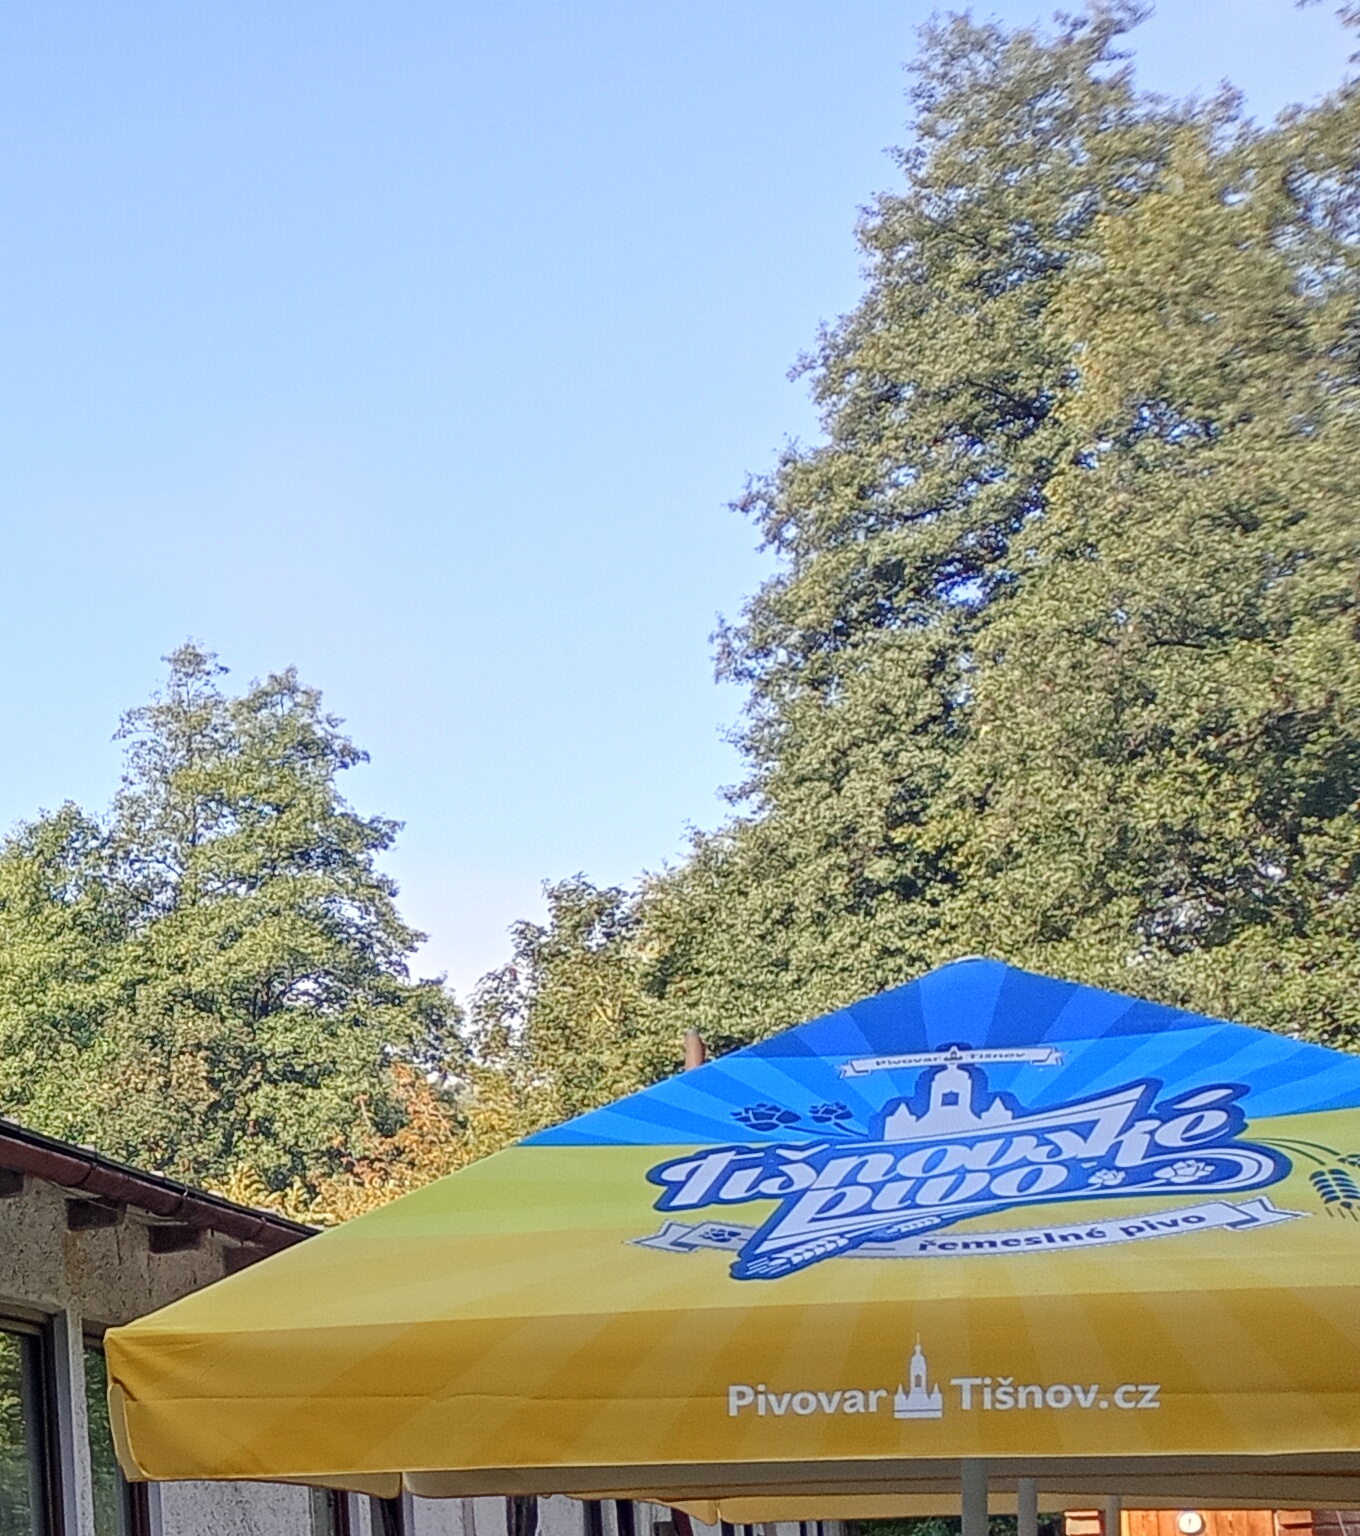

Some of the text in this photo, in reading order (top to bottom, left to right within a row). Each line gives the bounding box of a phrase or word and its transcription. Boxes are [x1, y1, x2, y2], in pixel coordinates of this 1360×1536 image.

[875, 1056, 938, 1067] Pivovar
[660, 1084, 1236, 1208] Tišnovské
[754, 1163, 1076, 1254] pivo
[918, 1214, 1207, 1251] řemeslné pivo
[727, 1376, 1161, 1417] Pivovar Tišnov.cz
